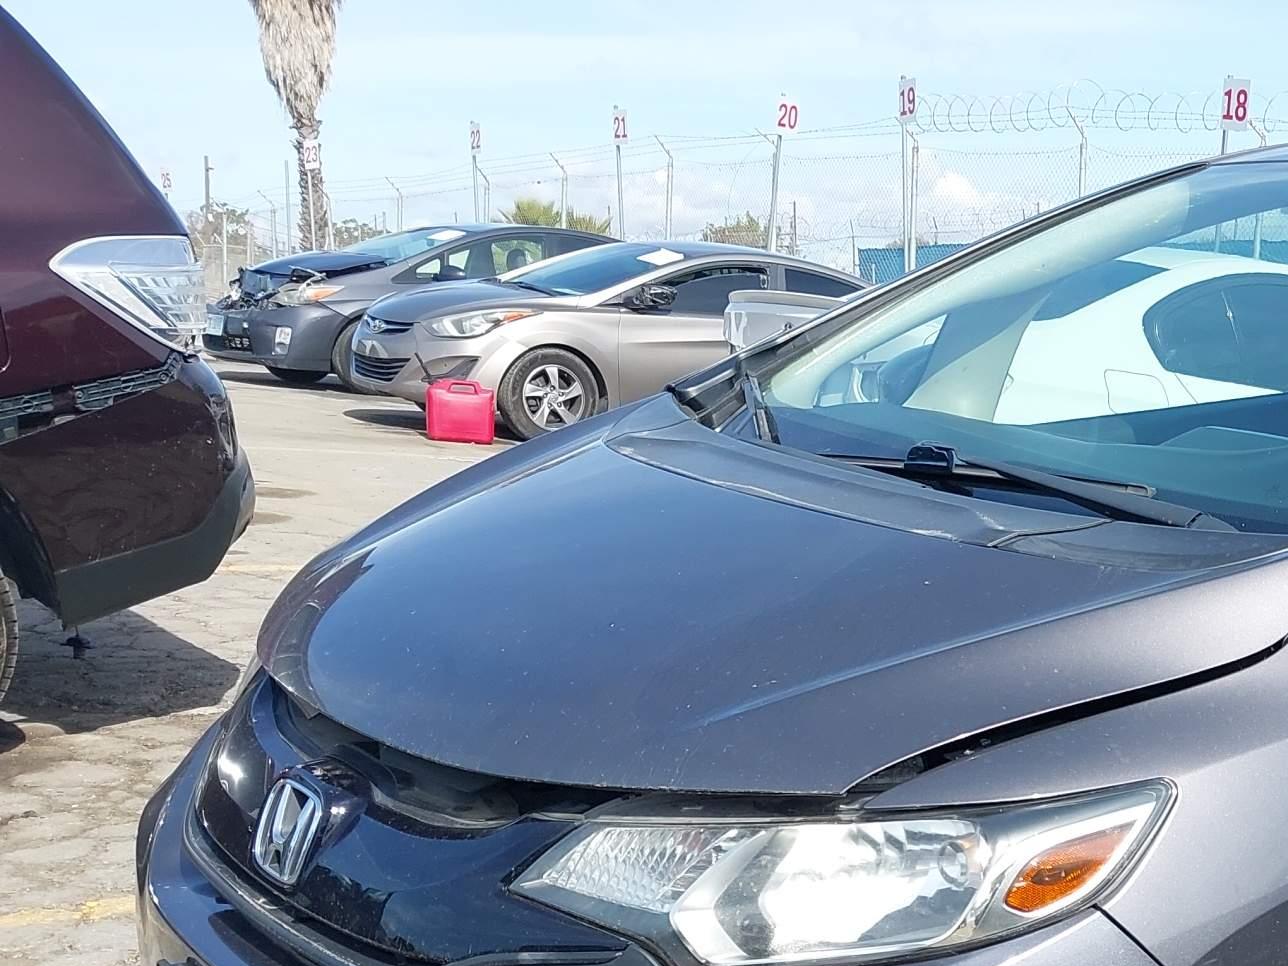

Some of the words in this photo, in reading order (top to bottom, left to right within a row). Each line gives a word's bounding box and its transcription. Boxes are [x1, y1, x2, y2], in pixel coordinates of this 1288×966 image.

[899, 86, 916, 116] 19
[1222, 88, 1248, 122] 18
[613, 115, 628, 139] 21
[777, 103, 798, 129] 20
[470, 129, 481, 150] 22
[305, 146, 318, 164] 23
[160, 172, 172, 189] 25
